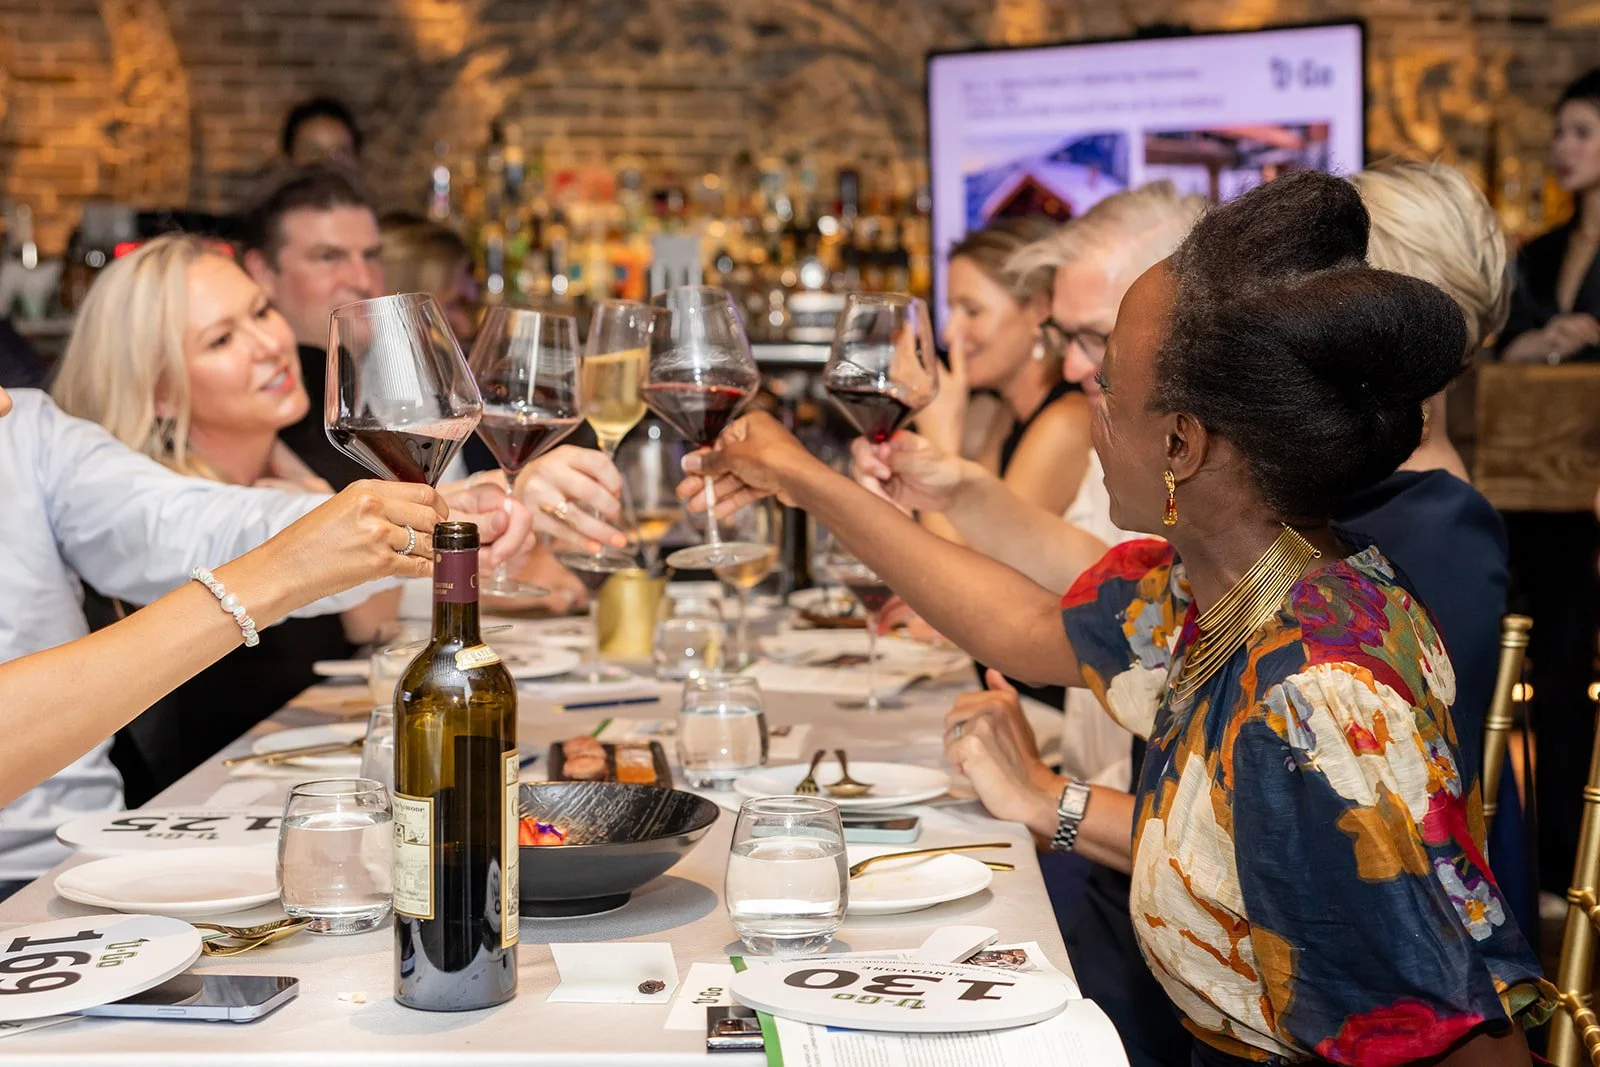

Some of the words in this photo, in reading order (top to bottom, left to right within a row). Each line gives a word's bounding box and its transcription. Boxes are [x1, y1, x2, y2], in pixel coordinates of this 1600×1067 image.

[102, 816, 282, 832] 125
[0, 929, 104, 995] 169
[96, 938, 151, 969] U-Go
[861, 965, 965, 977] SINGAPORE
[783, 968, 1015, 1001] 130
[691, 986, 724, 1005] U-Go
[832, 992, 926, 1010] U-Go
